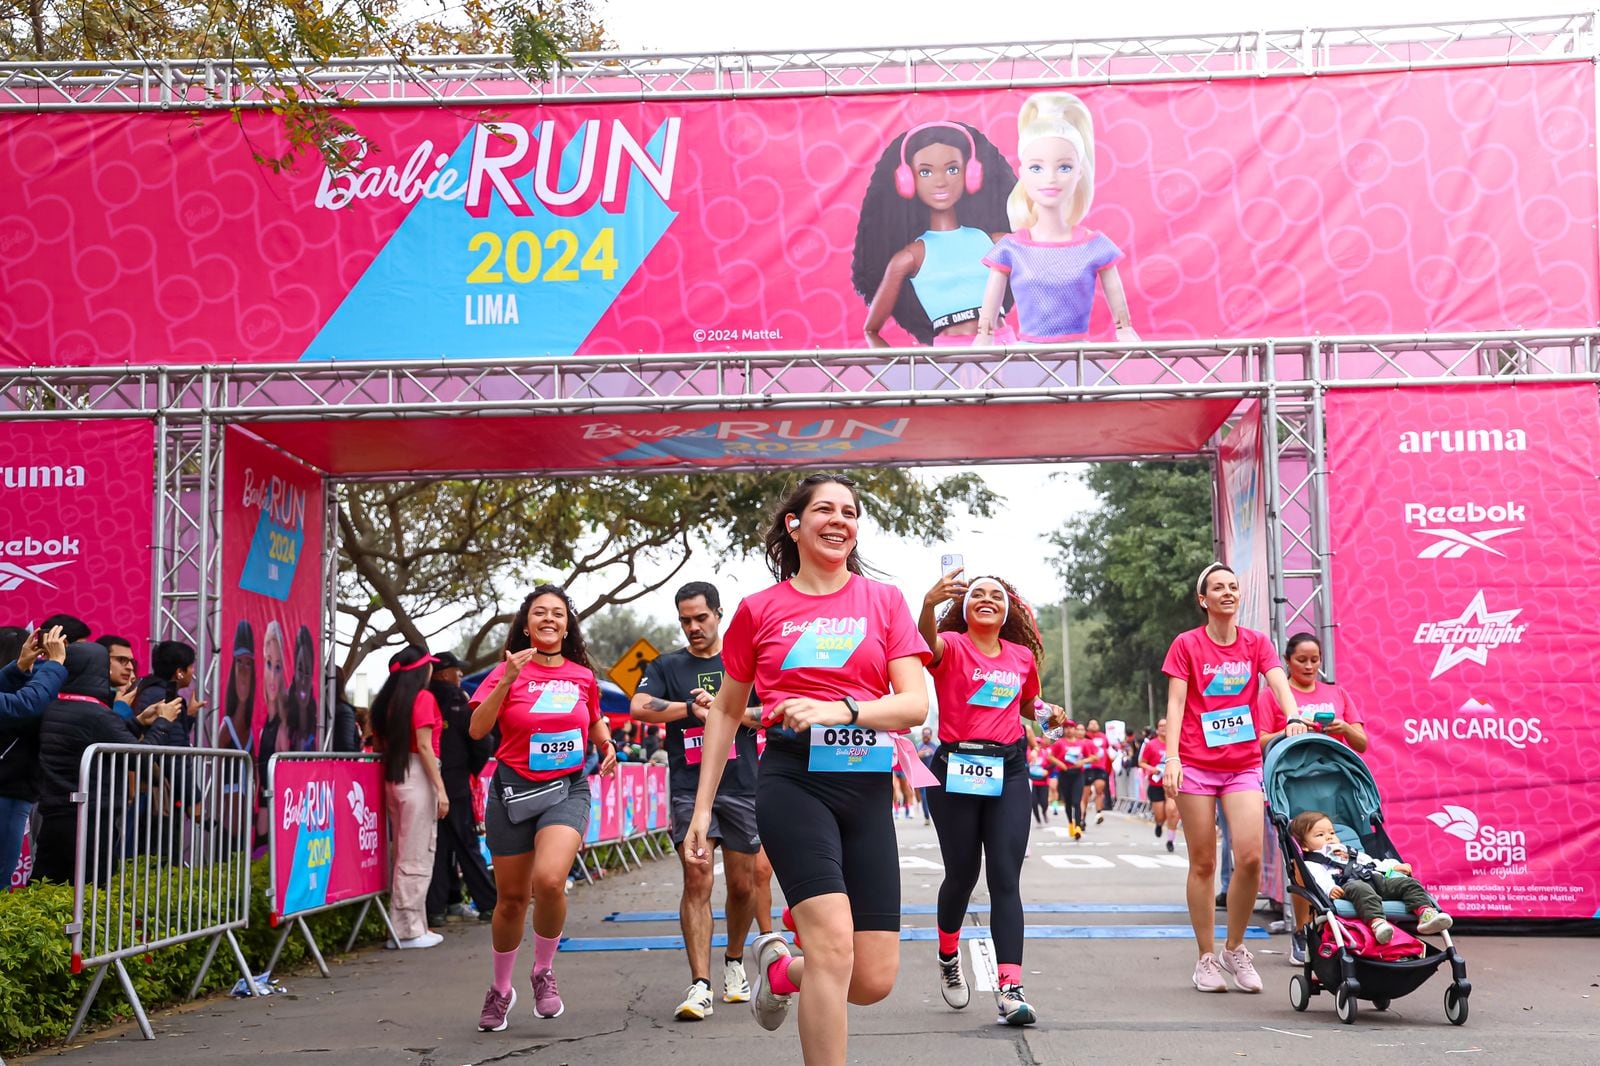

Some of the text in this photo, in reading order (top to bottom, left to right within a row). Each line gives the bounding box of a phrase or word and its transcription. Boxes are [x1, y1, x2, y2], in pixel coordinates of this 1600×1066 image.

[314, 116, 682, 211] Barbie RUN
[466, 227, 618, 284] 2024
[465, 294, 519, 325] LIMA
[952, 310, 975, 323] DANCE
[741, 328, 783, 340] Mattel.
[580, 418, 910, 440] Barbie RUN
[1399, 429, 1527, 453] aruma
[270, 475, 305, 530] RUN
[1405, 502, 1525, 527] Reebok
[269, 530, 295, 565] 2024
[815, 617, 867, 635] RUN
[1413, 622, 1526, 649] Electrolight
[815, 636, 854, 649] 2024
[993, 670, 1020, 686] RUN
[1222, 661, 1251, 676] RUN
[549, 680, 579, 694] RUN
[992, 687, 1014, 698] 2024
[1212, 716, 1243, 730] 0754
[1404, 718, 1449, 744] SAN
[541, 741, 575, 753] 0329
[824, 729, 877, 746] 0363
[849, 747, 869, 757] RUN
[959, 764, 993, 777] 1405
[306, 780, 335, 827] RUN
[363, 806, 378, 830] San
[359, 826, 378, 856] Borja
[1480, 825, 1526, 846] San
[308, 836, 331, 868] 2024
[1465, 841, 1527, 866] Borja
[1473, 867, 1487, 875] mi
[1468, 884, 1505, 892] asociadas
[1527, 884, 1568, 892] elementos
[1451, 893, 1479, 901] utilizan
[1480, 893, 1497, 903] bajo
[1499, 893, 1506, 901] la
[1507, 893, 1539, 901] licencia
[1540, 893, 1548, 901] de
[1550, 893, 1576, 902] Mattel.
